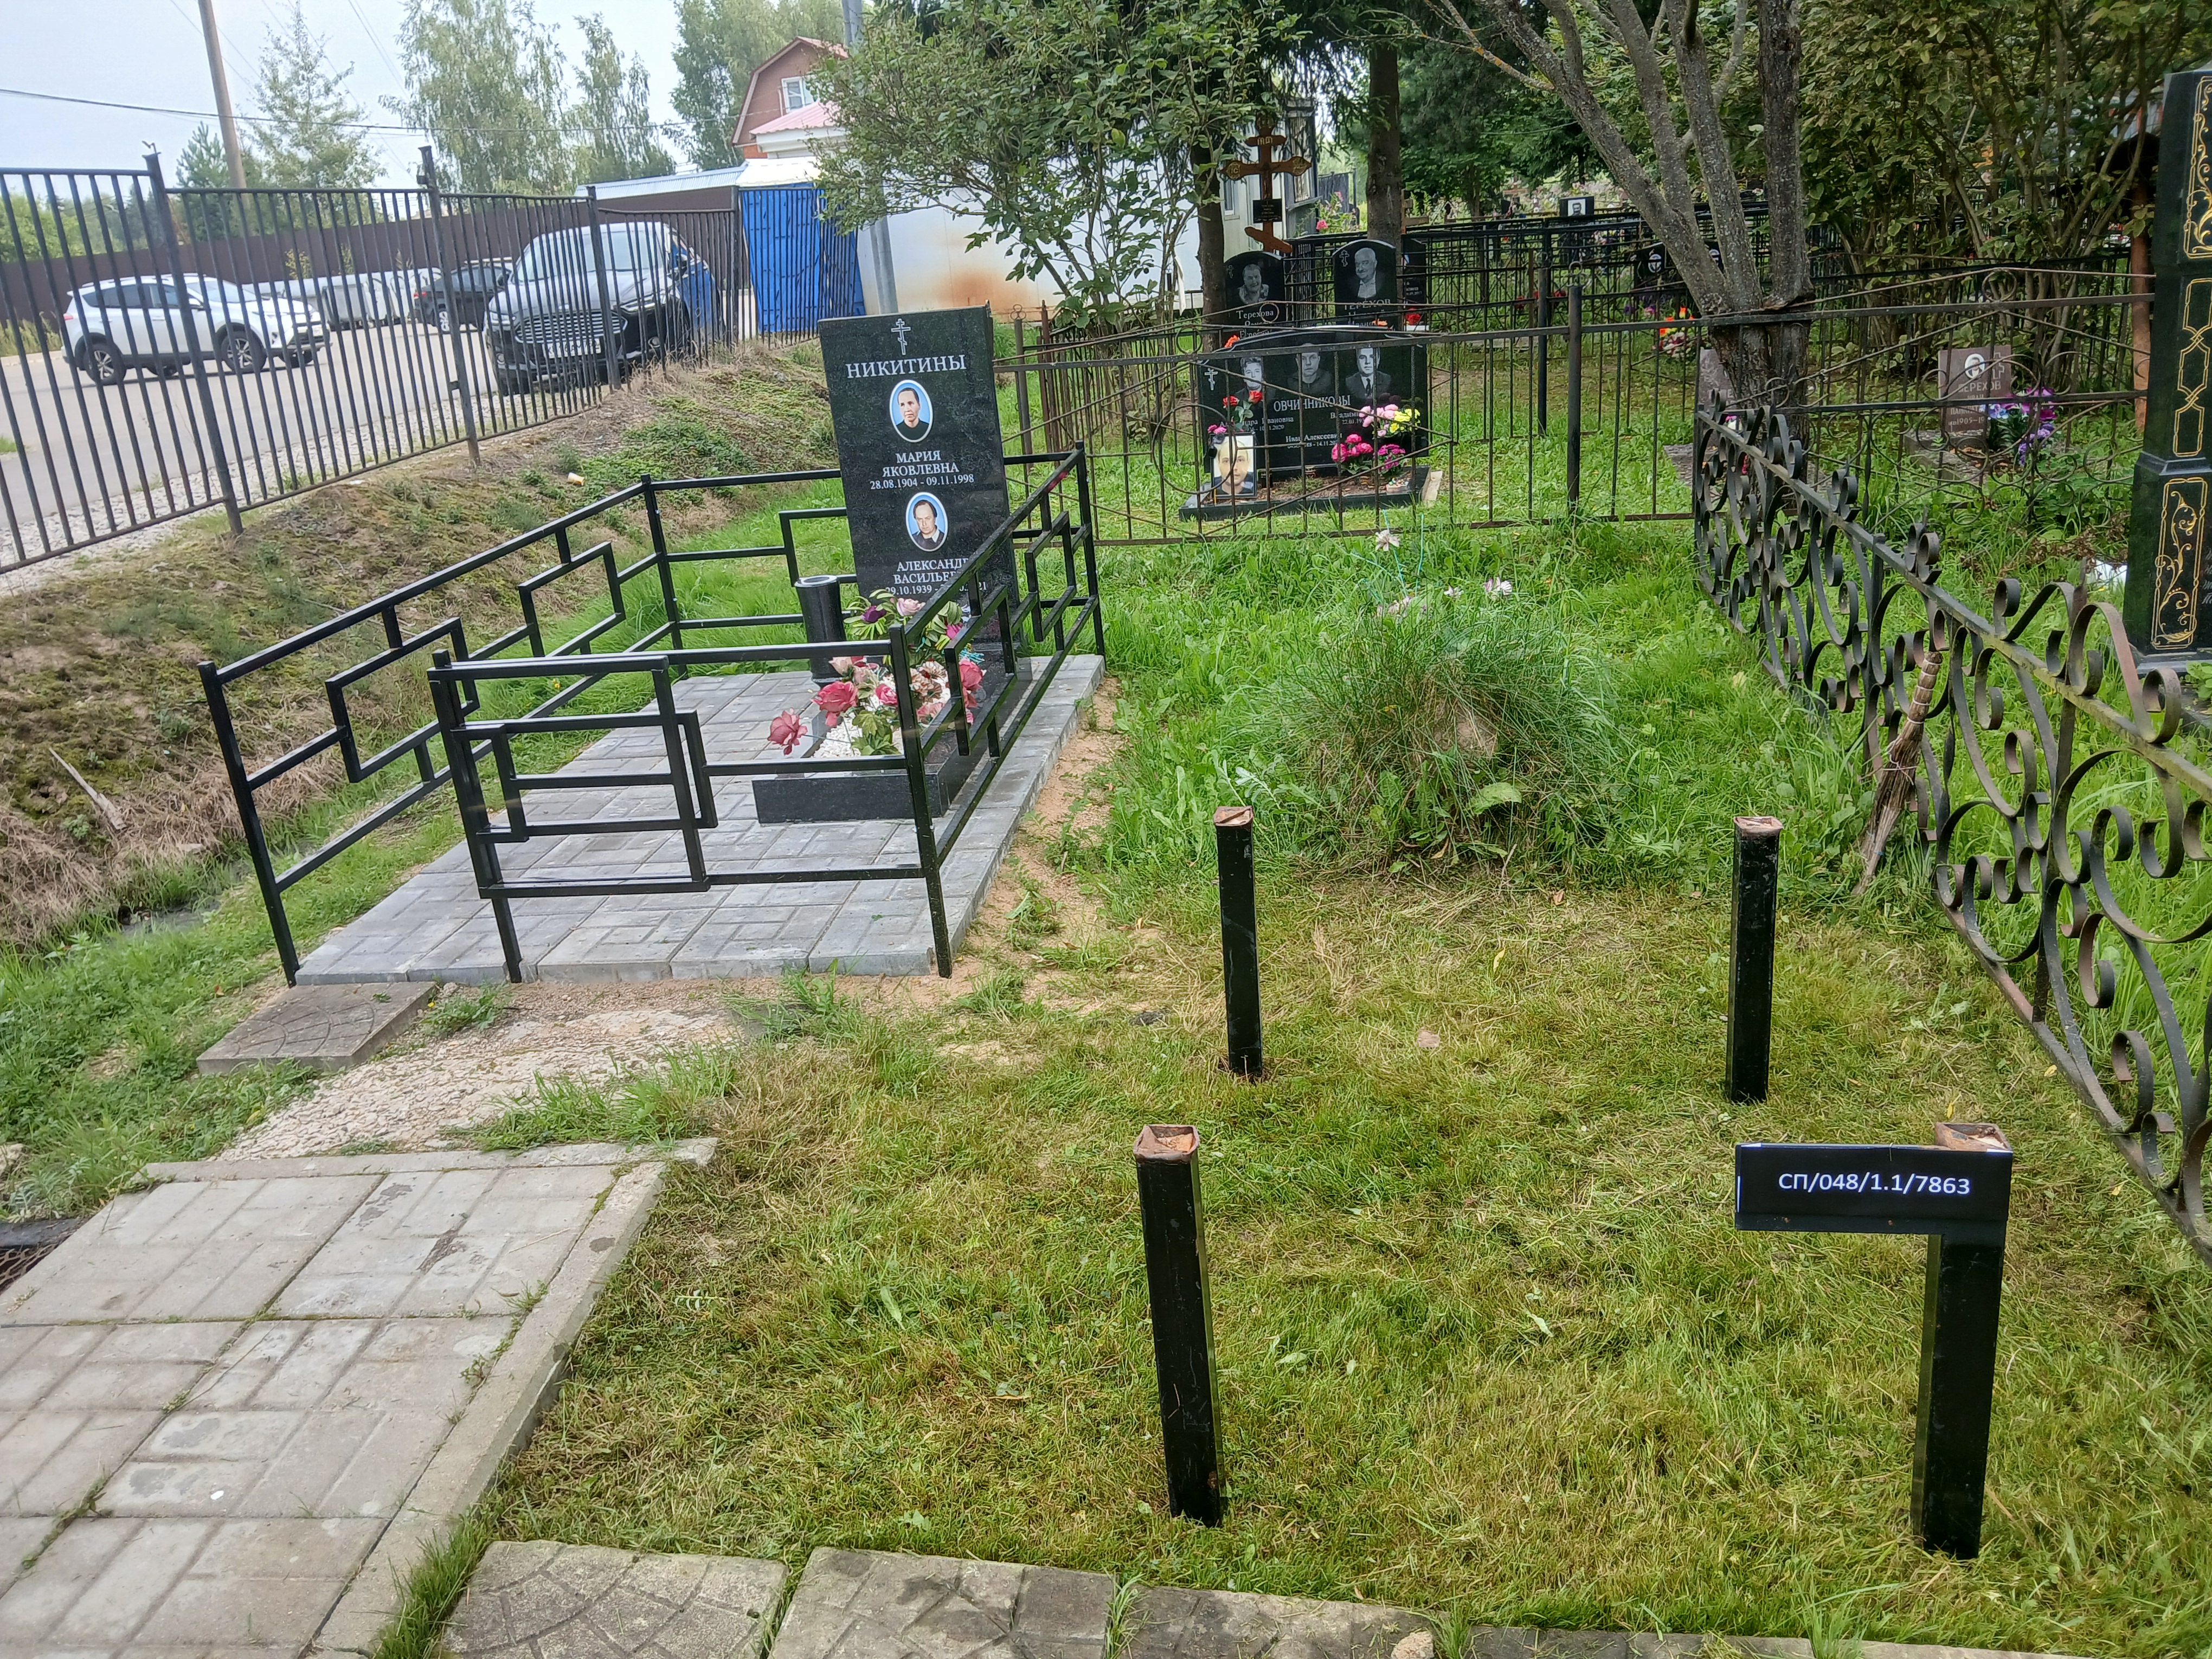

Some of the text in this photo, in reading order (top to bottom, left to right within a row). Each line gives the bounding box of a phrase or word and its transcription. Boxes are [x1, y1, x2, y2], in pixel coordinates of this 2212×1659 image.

[845, 354, 967, 379] НИКИТИНЫ
[895, 450, 942, 464] МАРИЯ
[882, 462, 960, 477] ЯКОВЛЕВНА
[869, 478, 918, 490] 28.08.1904
[926, 474, 974, 486] 09.11.1998
[1778, 1172, 1970, 1195] СП/048/1.1/7863
